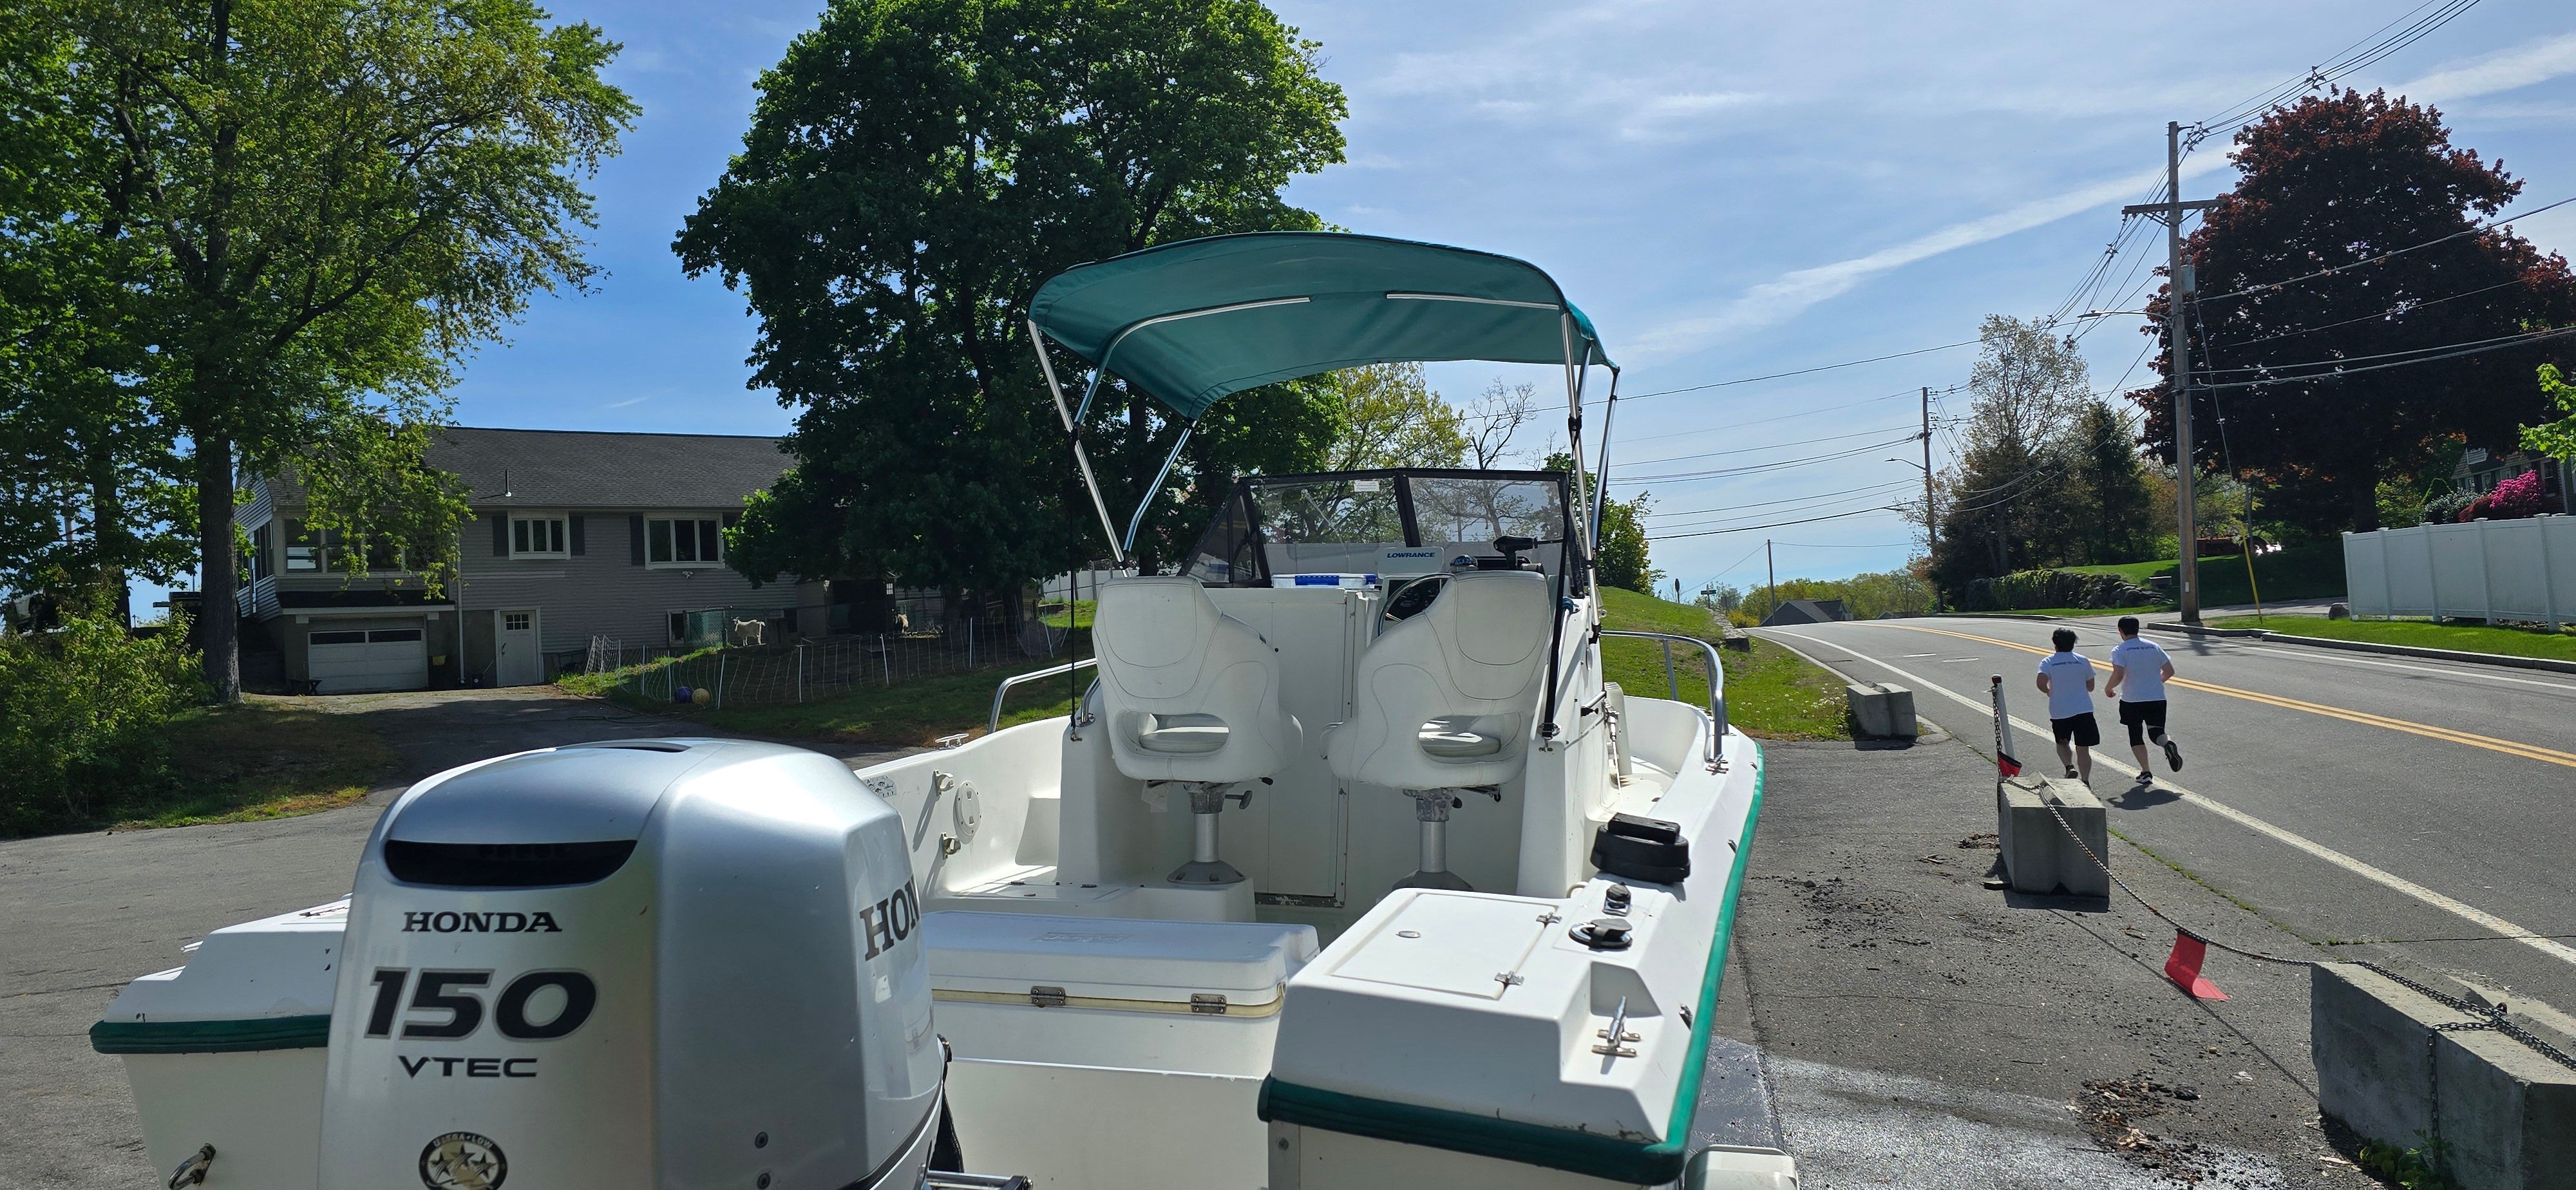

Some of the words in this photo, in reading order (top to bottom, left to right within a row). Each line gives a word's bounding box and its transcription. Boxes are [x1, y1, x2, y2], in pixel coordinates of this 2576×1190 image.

[402, 911, 562, 933] HONDA
[860, 874, 920, 961] HON
[364, 967, 598, 1043] 150
[398, 1055, 538, 1078] VTEC
